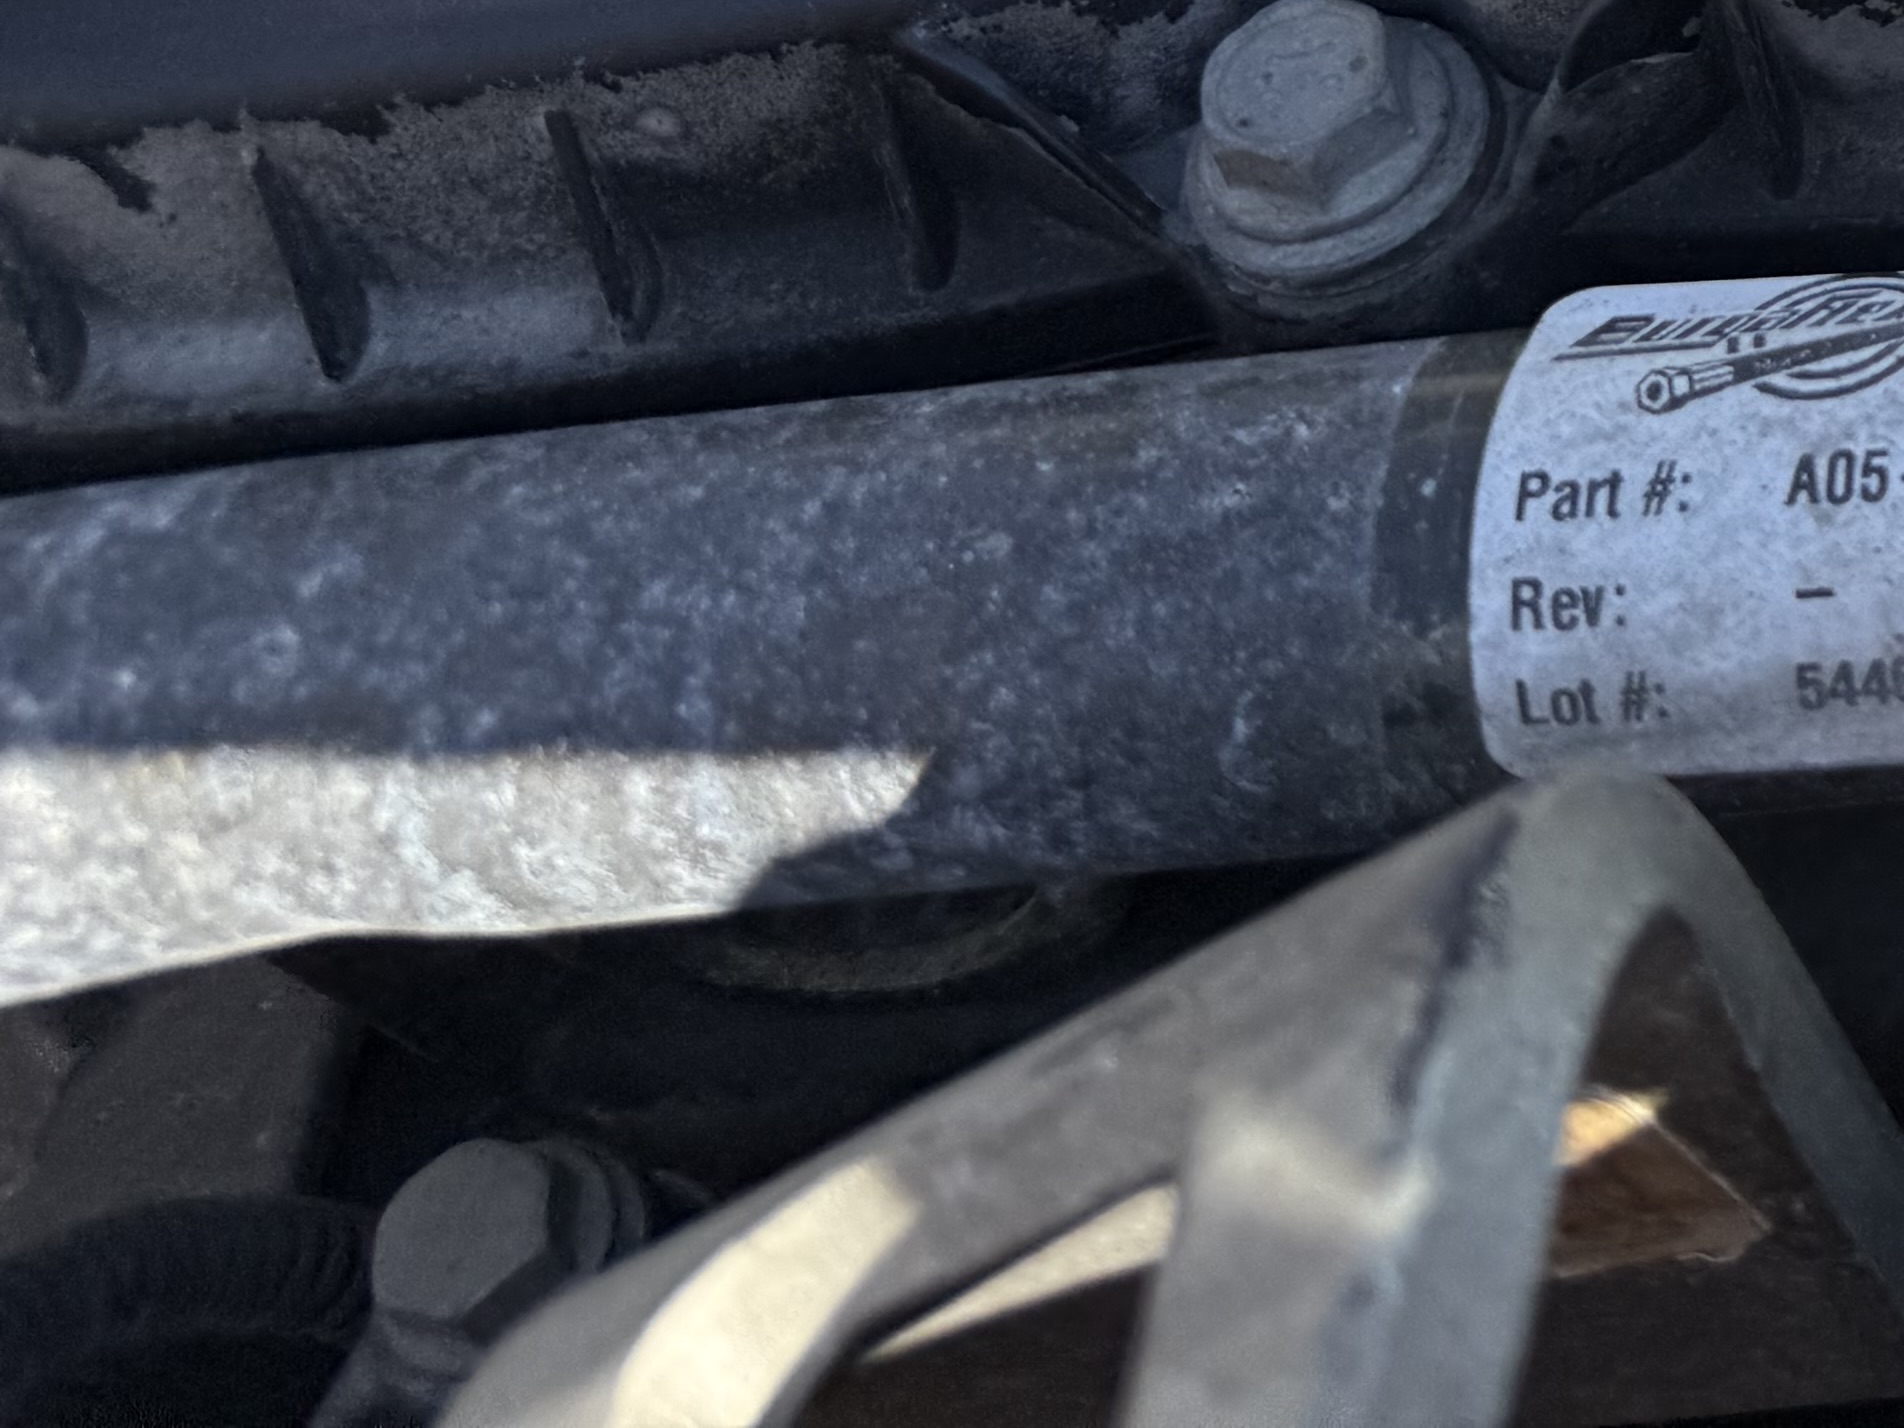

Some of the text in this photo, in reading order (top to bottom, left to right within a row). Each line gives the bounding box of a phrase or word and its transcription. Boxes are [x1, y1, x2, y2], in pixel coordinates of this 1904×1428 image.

[1514, 469, 1621, 521] Part
[1640, 461, 1692, 517] #:
[1510, 578, 1627, 632] Rev:
[1515, 679, 1600, 726] Lot
[1619, 671, 1670, 721] #:
